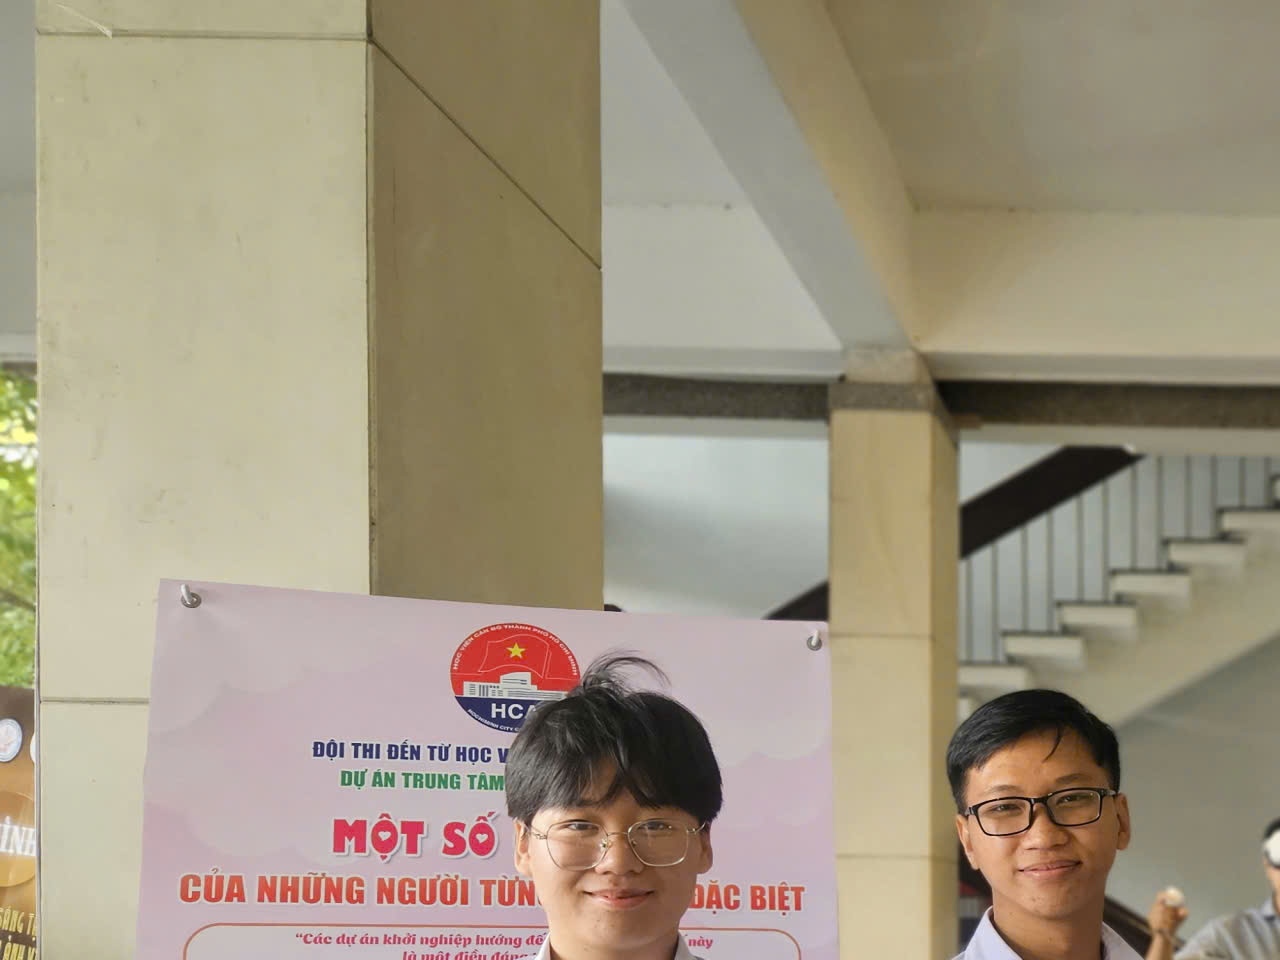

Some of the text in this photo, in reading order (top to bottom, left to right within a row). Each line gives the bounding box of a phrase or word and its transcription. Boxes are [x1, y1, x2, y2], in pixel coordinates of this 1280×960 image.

[313, 739, 345, 761] ĐỘI
[351, 742, 381, 759] THI
[387, 739, 421, 761] ĐẾN
[427, 743, 451, 762] TỪ
[455, 746, 492, 766] HỌC
[340, 768, 505, 791] DỰ ÁN TRUNG TÂM
[332, 811, 496, 861] MỘT SỐ
[179, 867, 246, 904] CỦA
[257, 872, 365, 905] NHỮNG
[376, 874, 469, 906] NGƯỜI
[480, 876, 543, 907] TỪN
[750, 882, 805, 916] BIỆT
[336, 932, 356, 949] dự
[359, 933, 379, 945] án
[383, 931, 416, 946] khởi
[420, 934, 471, 950] nghiệp
[475, 934, 522, 949] hướng
[688, 936, 713, 950] này
